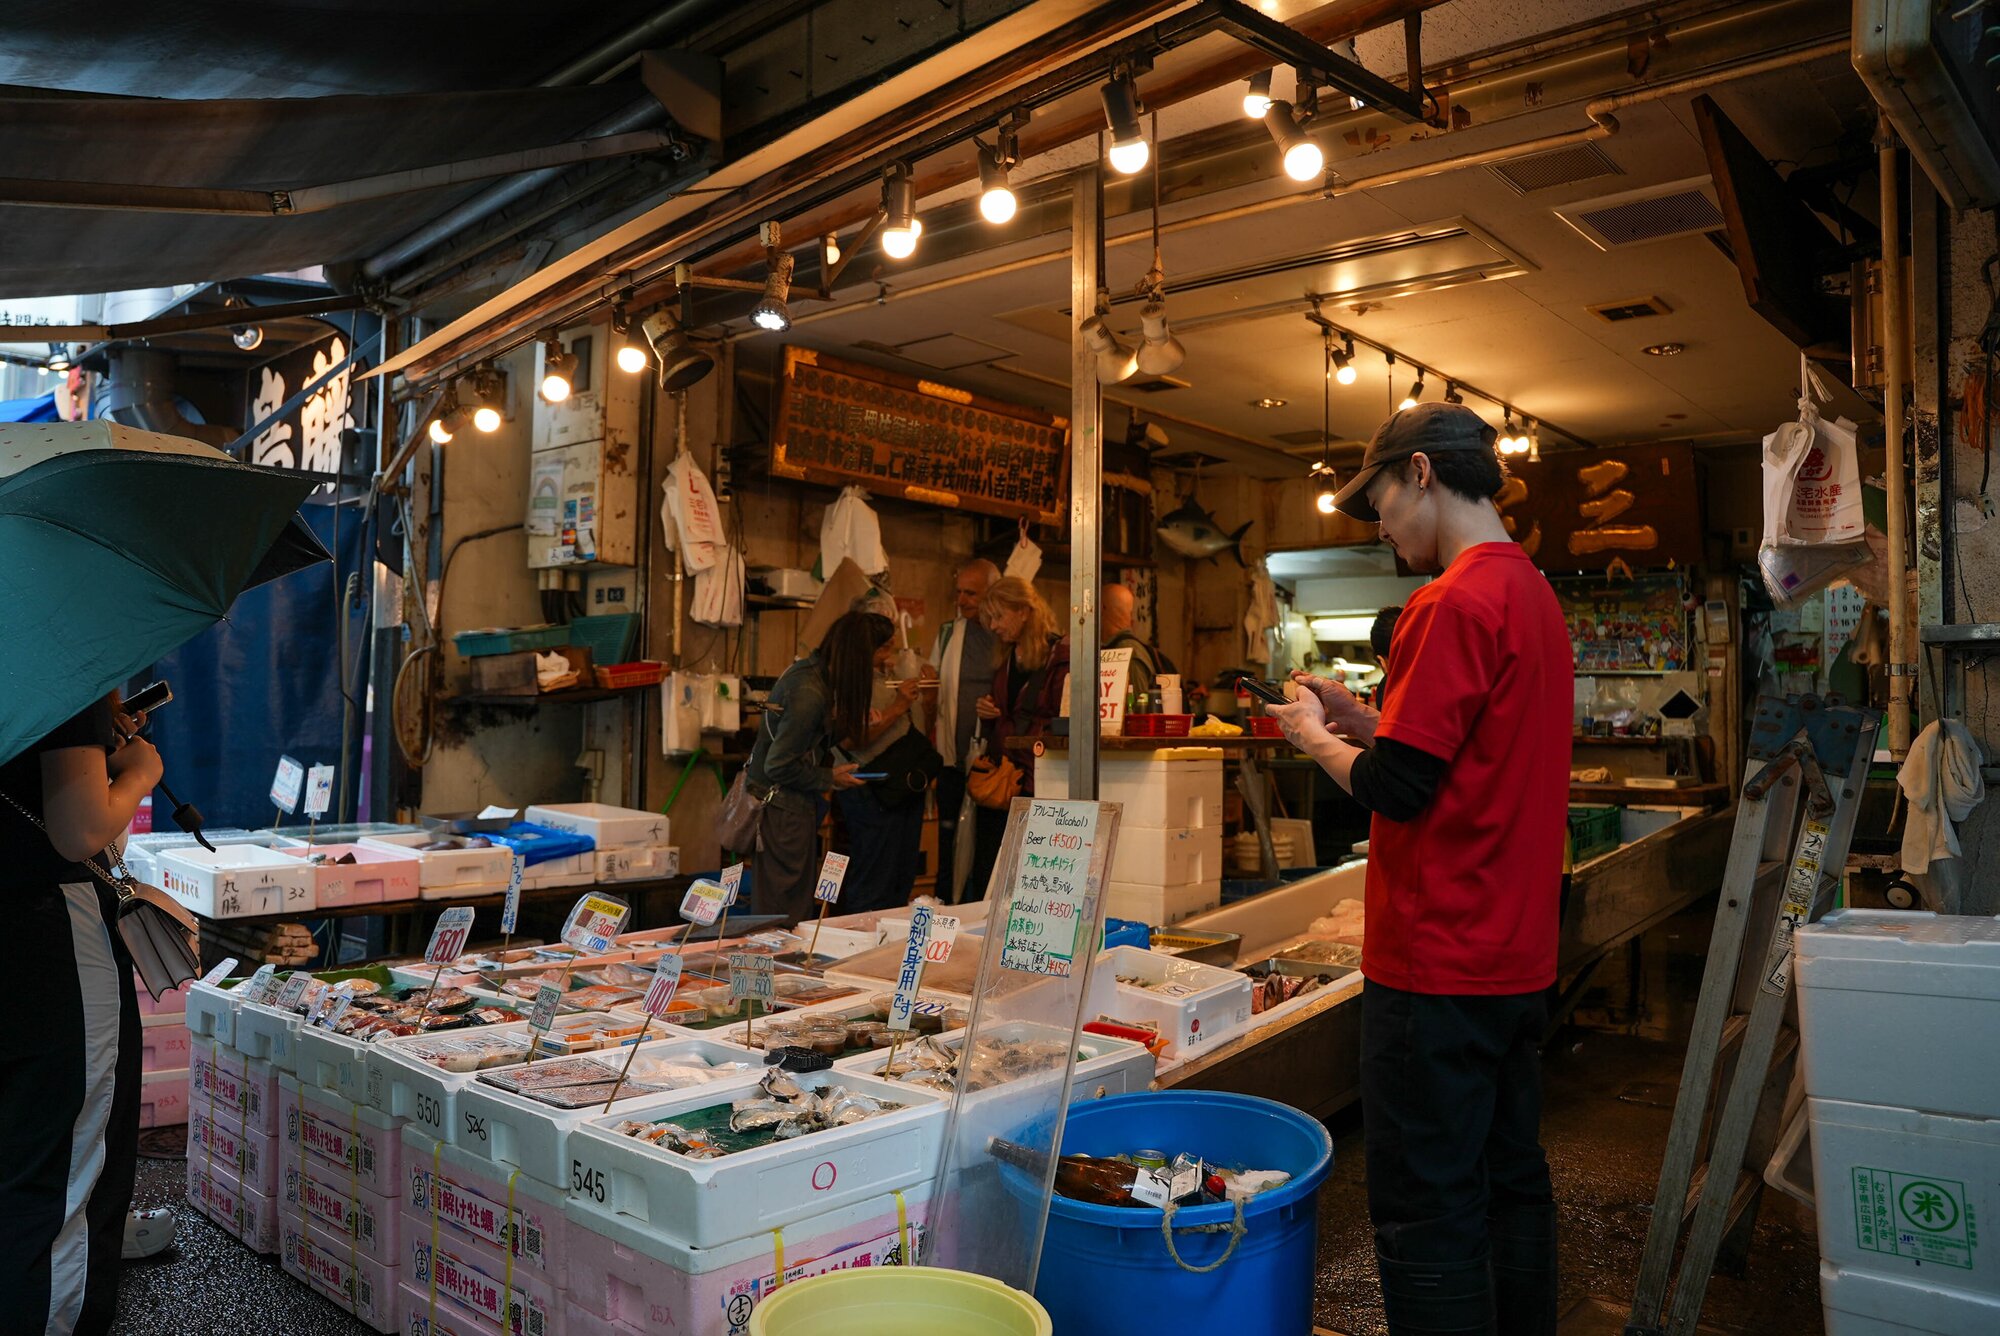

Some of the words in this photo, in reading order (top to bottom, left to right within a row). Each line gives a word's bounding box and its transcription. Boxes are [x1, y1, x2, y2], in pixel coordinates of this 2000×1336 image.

[1842, 605, 1848, 613] 9
[1853, 605, 1861, 613] 10
[1841, 619, 1850, 627] 16
[1033, 804, 1069, 818] アルコール
[1055, 816, 1088, 827] (alcohol)
[1026, 831, 1046, 845] Beer
[288, 887, 306, 901] 32
[1015, 896, 1043, 914] alcohol
[1007, 937, 1048, 954] 氷結レモン
[417, 1092, 440, 1128] 550
[572, 1159, 605, 1203] 545
[1875, 1182, 1888, 1240] むき身かき
[1911, 1190, 1946, 1223] 米
[650, 1304, 676, 1328] 25入
[730, 1297, 749, 1324] 吉
